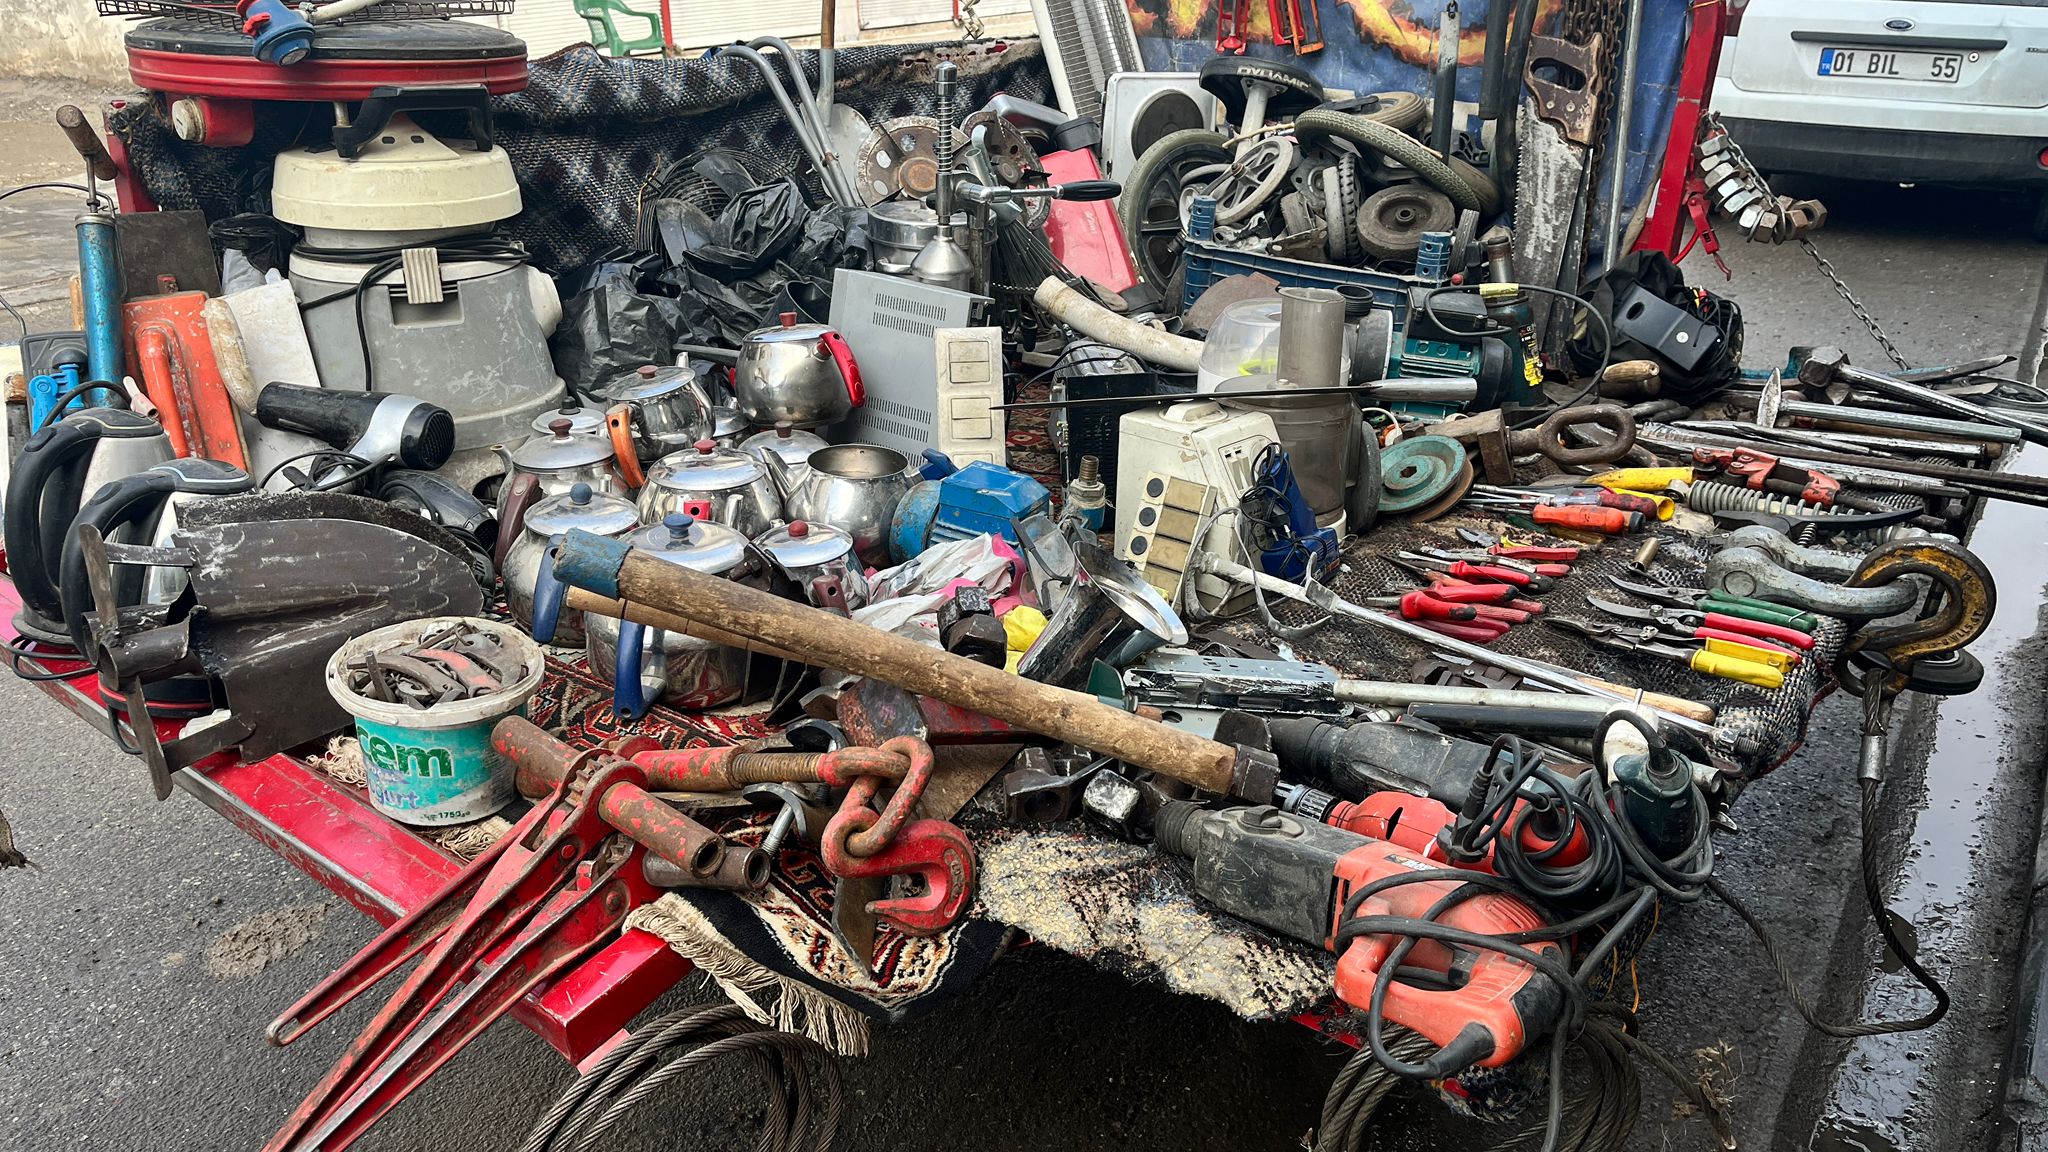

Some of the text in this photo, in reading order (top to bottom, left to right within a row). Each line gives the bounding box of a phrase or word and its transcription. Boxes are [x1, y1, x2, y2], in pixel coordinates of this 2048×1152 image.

[1237, 65, 1310, 89] DYNAMIC
[1833, 52, 1854, 73] 01
[1867, 53, 1899, 75] BIL
[1931, 56, 1958, 79] 55
